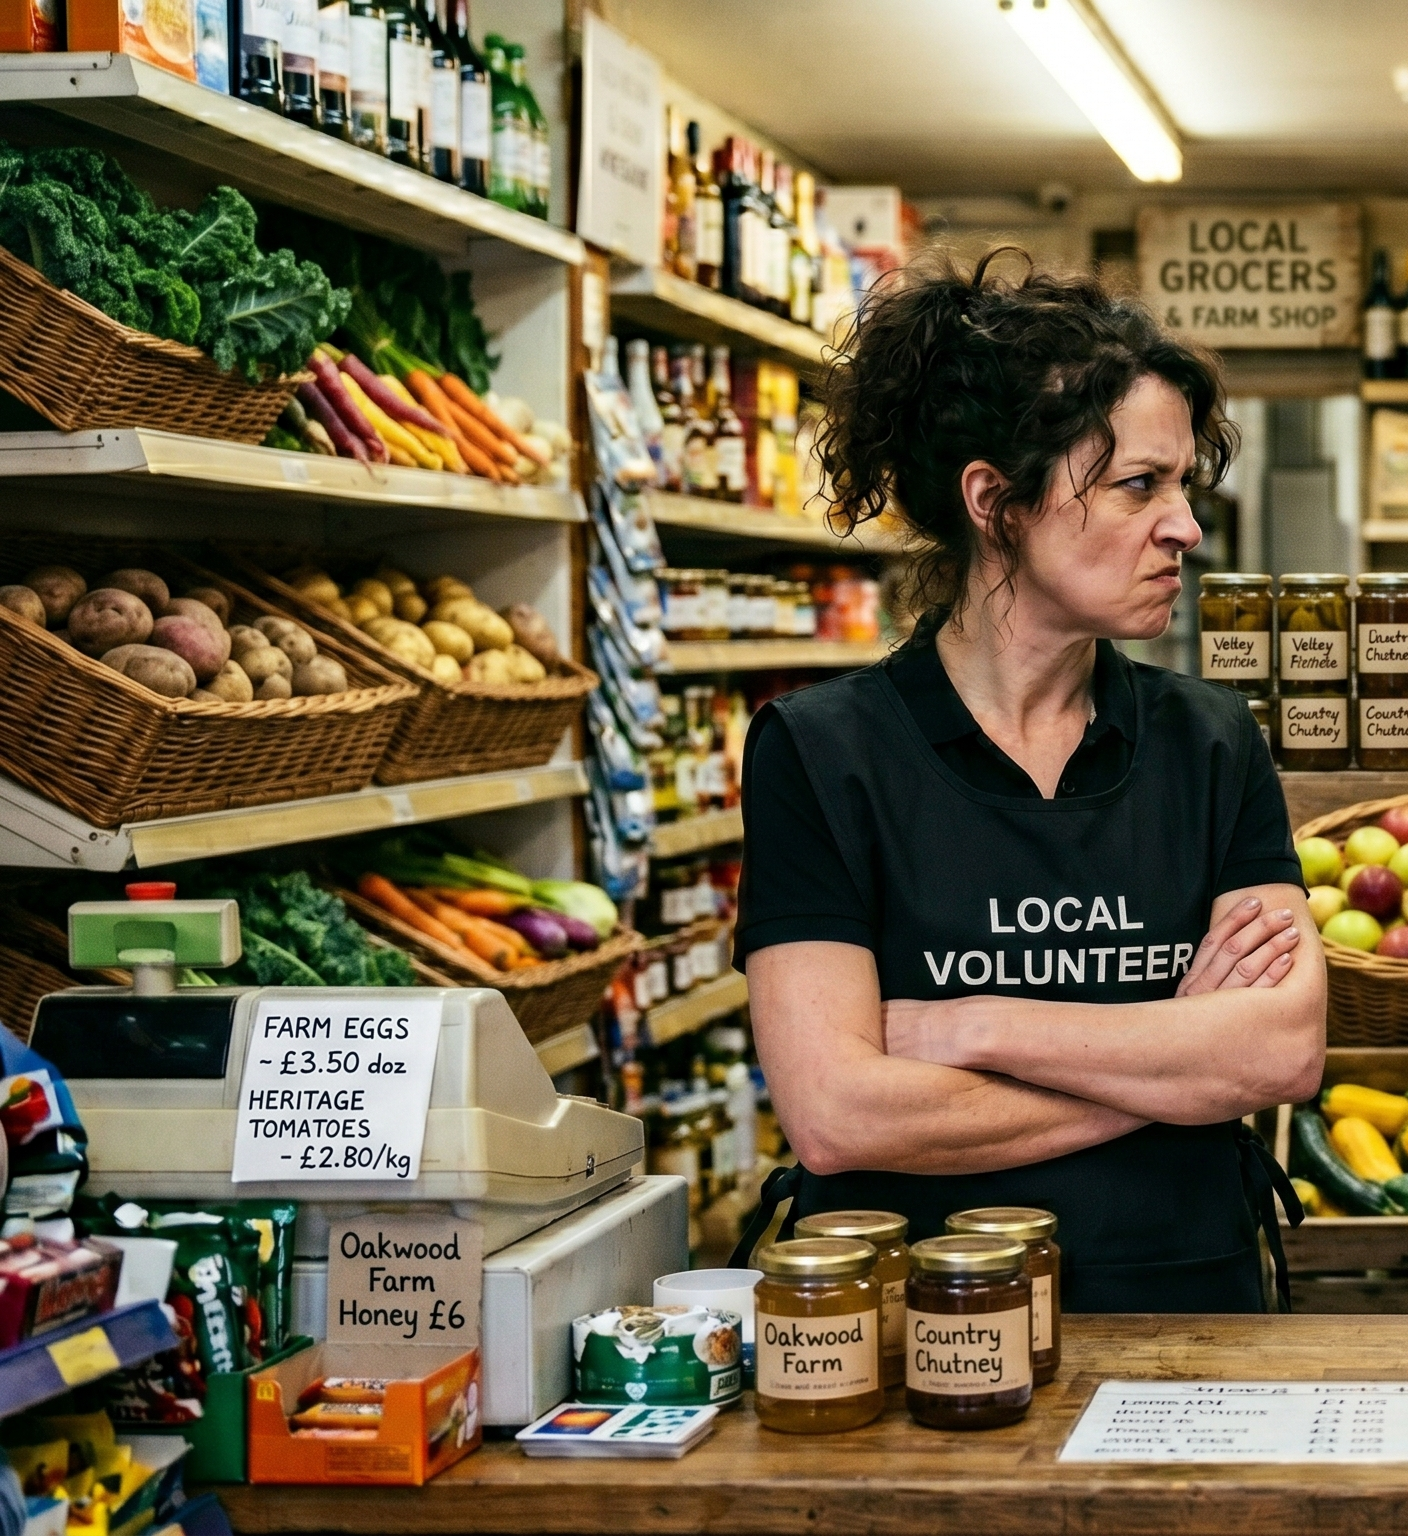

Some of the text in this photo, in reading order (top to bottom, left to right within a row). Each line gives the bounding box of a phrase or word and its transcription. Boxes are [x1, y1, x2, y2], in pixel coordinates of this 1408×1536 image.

[1188, 219, 1308, 254] LOCAL
[1159, 259, 1337, 293] GROCERS
[1165, 305, 1337, 328] & FARM SHOP
[989, 895, 1144, 933] LOCAL
[923, 942, 1195, 986] VOLUNTEER
[264, 1016, 409, 1040] FARM EGGS
[280, 1050, 360, 1075] £3.50
[368, 1052, 407, 1074] doz
[249, 1090, 365, 1110] HERITAGE
[249, 1118, 371, 1138] TOMATOES
[300, 1143, 411, 1178] £2.80/kg
[340, 1231, 461, 1260] Oakwood
[369, 1267, 435, 1292] Farm
[339, 1299, 465, 1339] Honey £6
[764, 1318, 864, 1348] Oakwood
[914, 1320, 1001, 1352] Country
[783, 1352, 843, 1374] Farm
[915, 1349, 1003, 1383] Chutney
